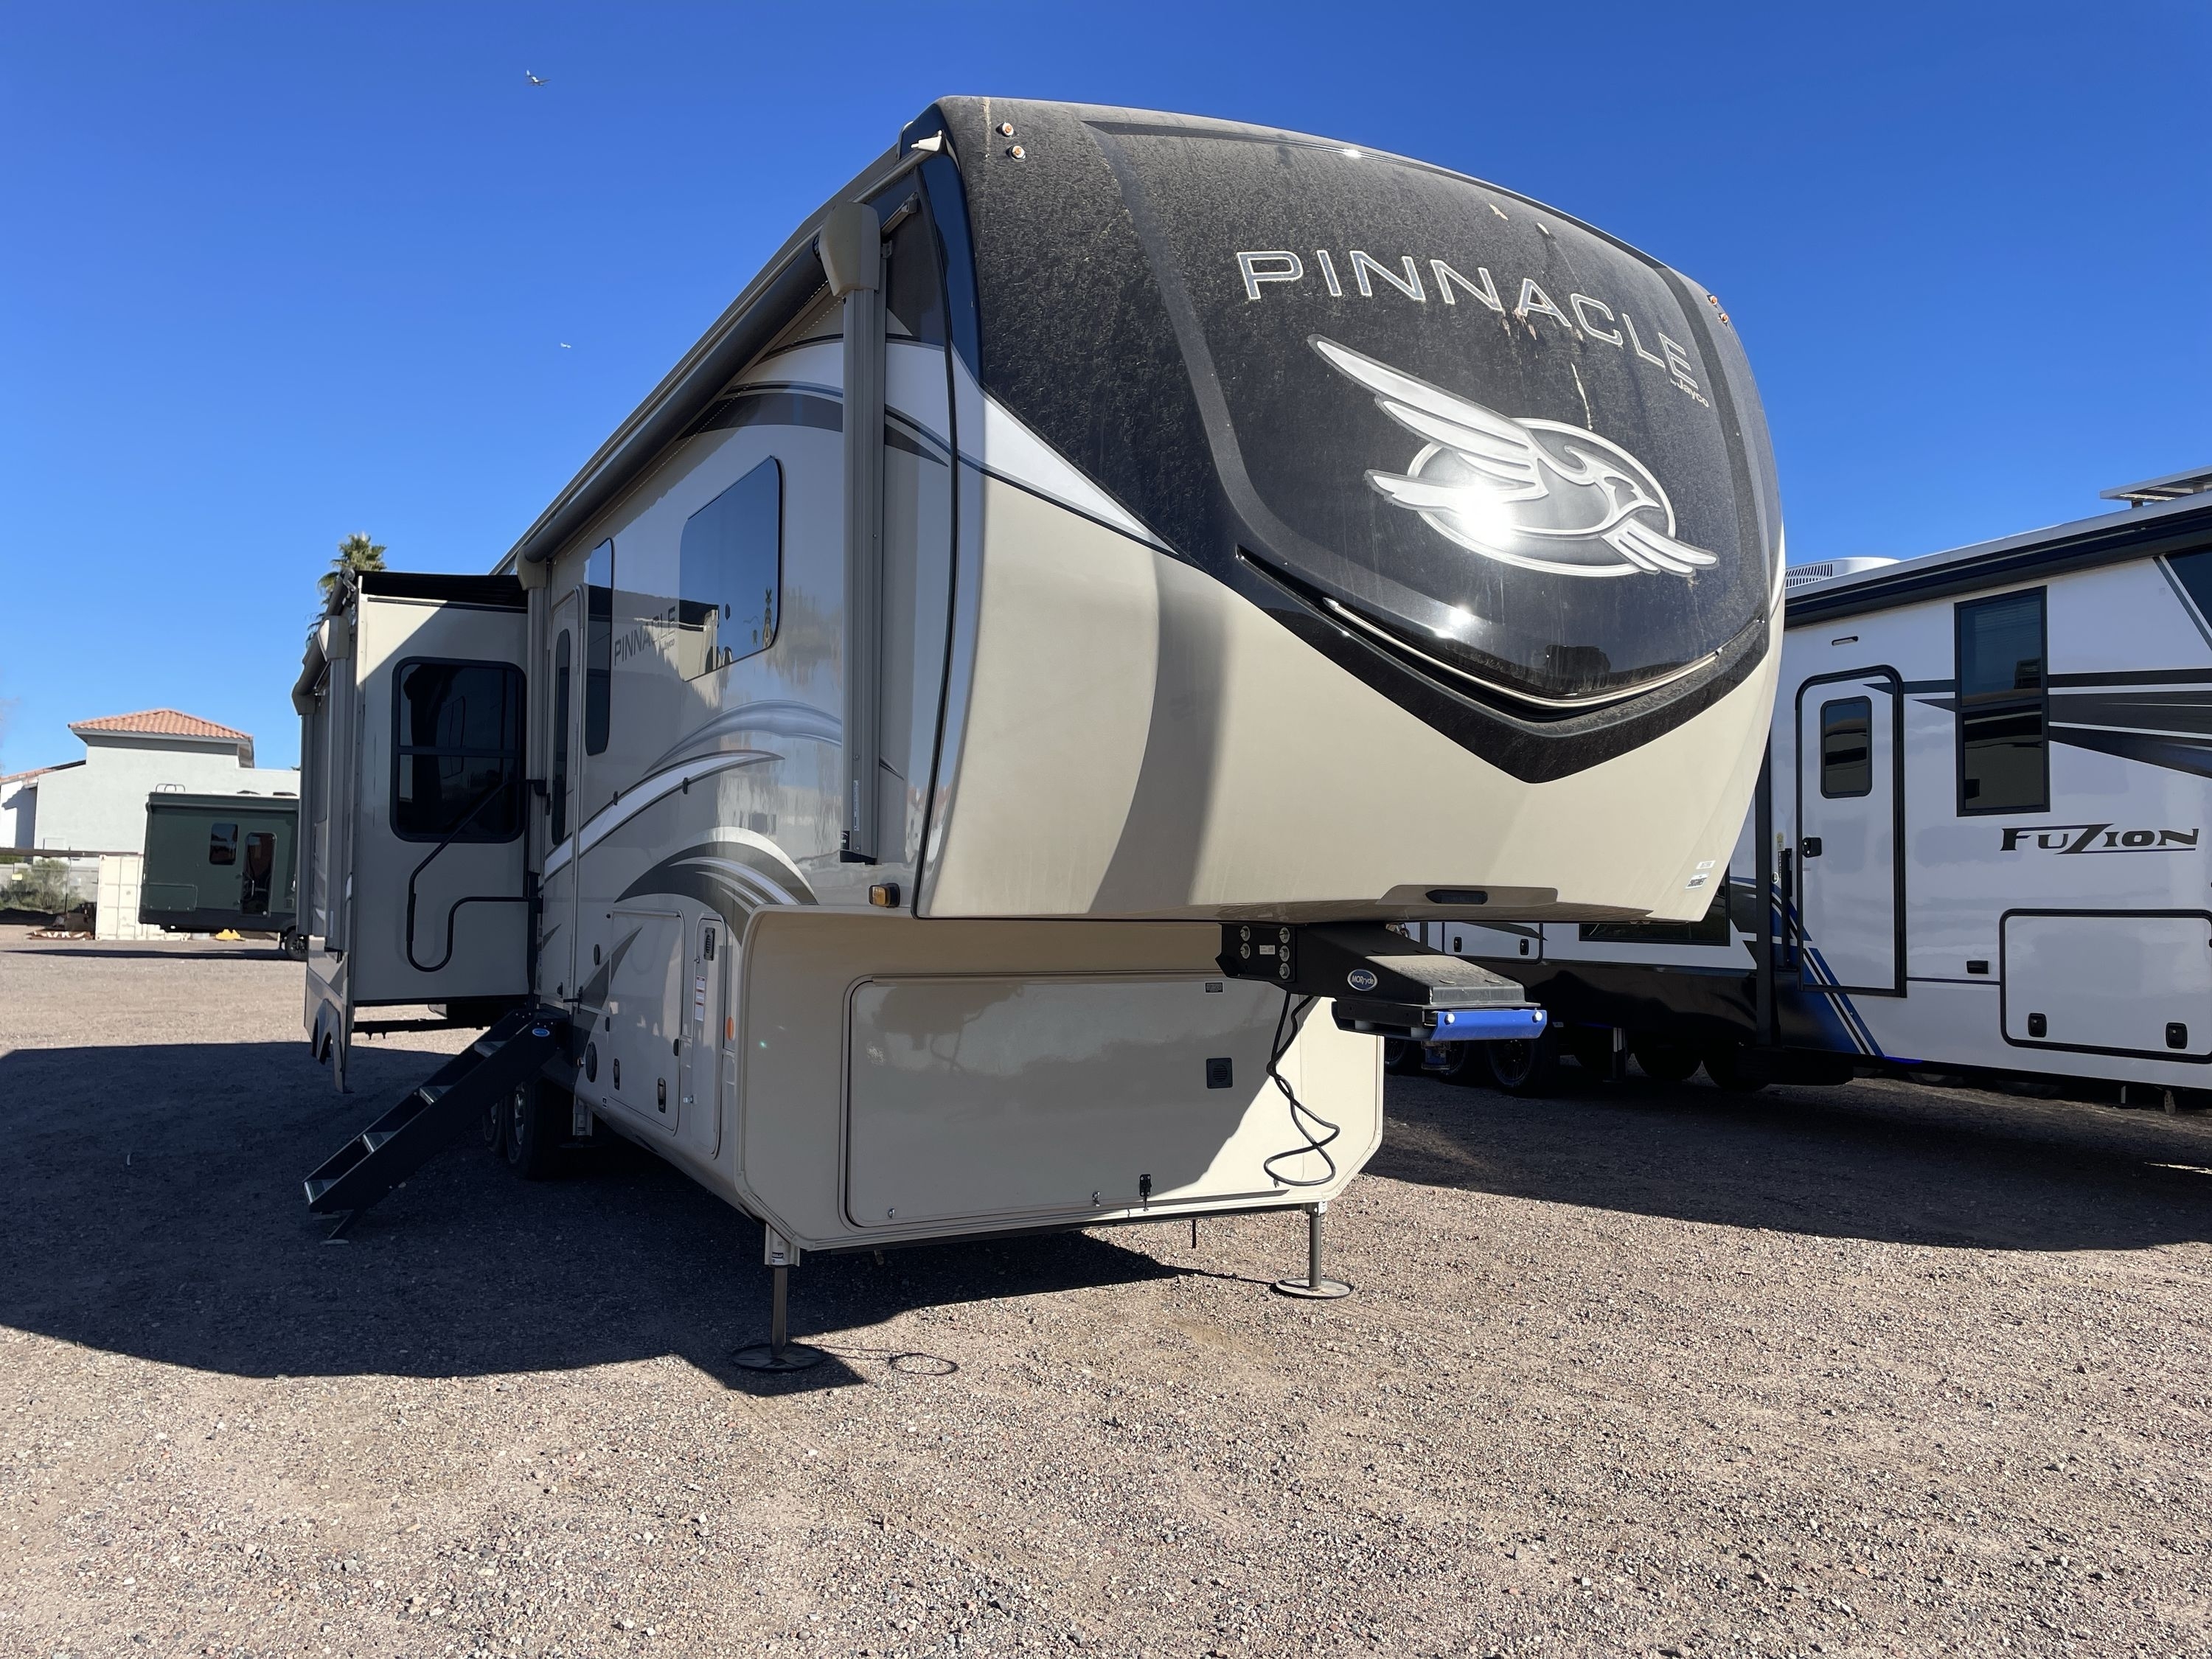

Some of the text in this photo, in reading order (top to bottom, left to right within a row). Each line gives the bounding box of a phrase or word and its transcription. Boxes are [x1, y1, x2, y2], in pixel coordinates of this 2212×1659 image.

[1237, 250, 1699, 390] PINNACLE
[1677, 378, 1710, 408] Jayco
[614, 605, 675, 667] PINNACLE
